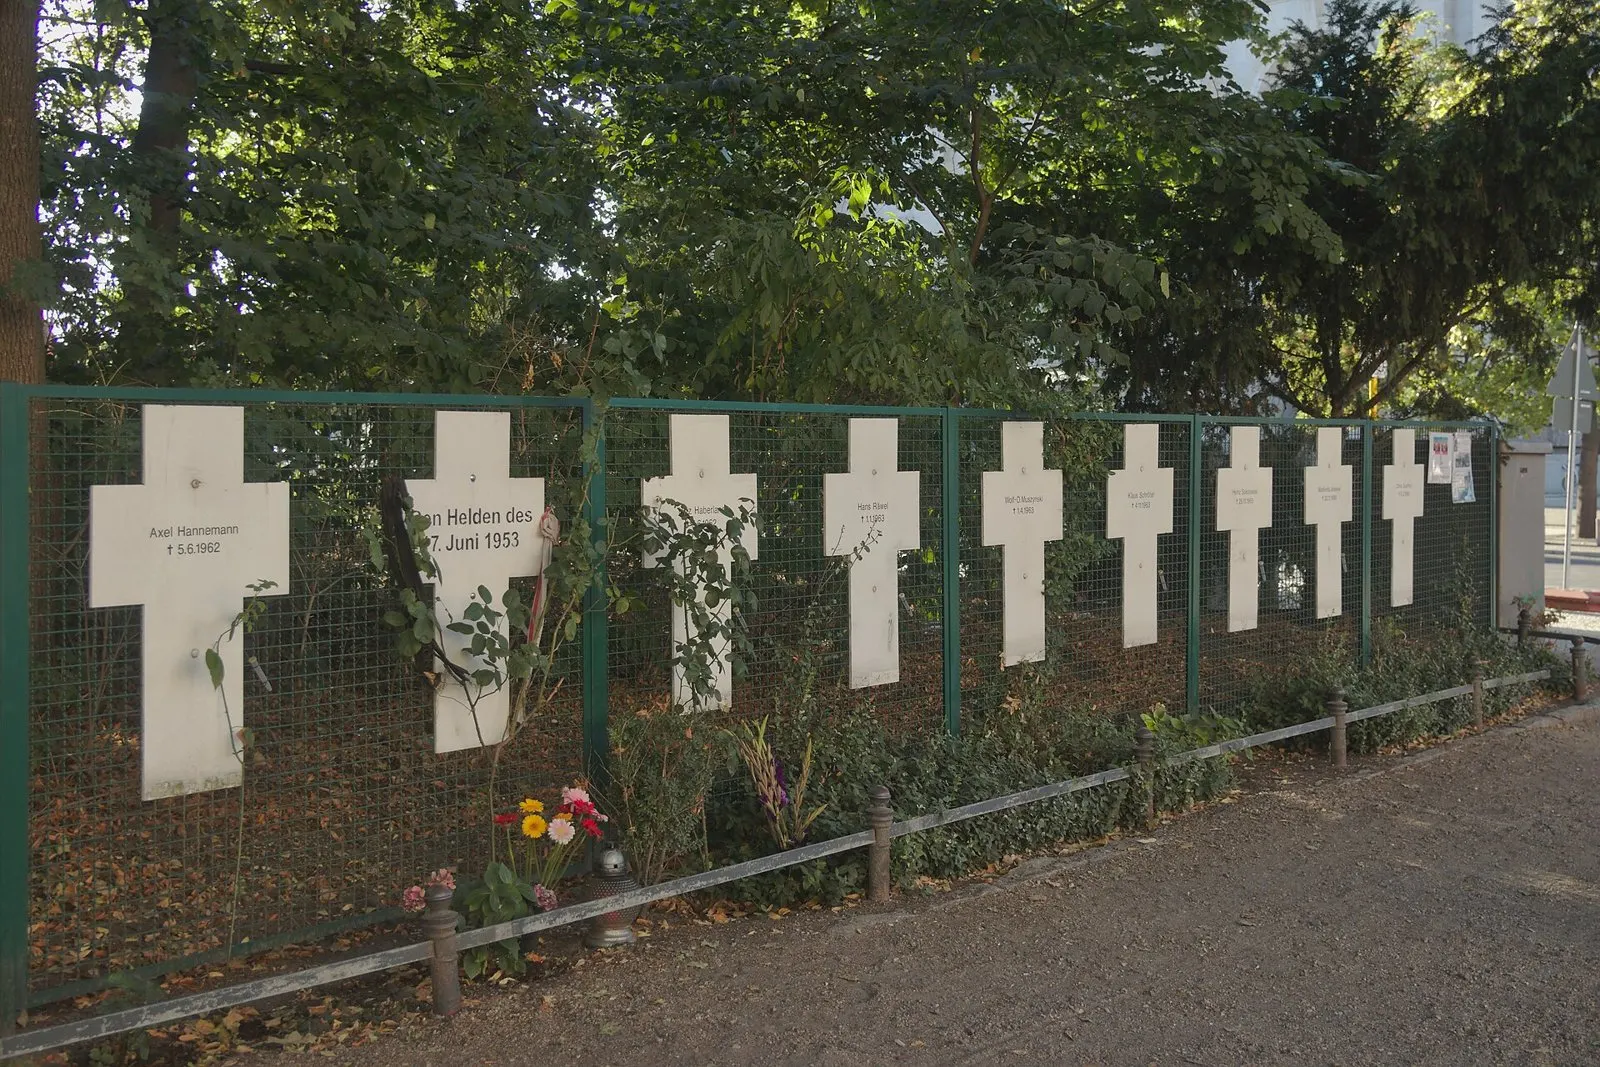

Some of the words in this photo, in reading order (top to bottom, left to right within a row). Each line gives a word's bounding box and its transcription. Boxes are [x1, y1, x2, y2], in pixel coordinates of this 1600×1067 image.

[857, 502, 871, 511] Hans
[447, 507, 501, 526] Helden
[506, 506, 533, 523] des
[150, 526, 173, 538] Axel
[177, 525, 239, 537] Hannemann
[445, 533, 479, 551] Juni
[484, 531, 520, 549] 1953
[177, 542, 221, 555] 5.6.1962
